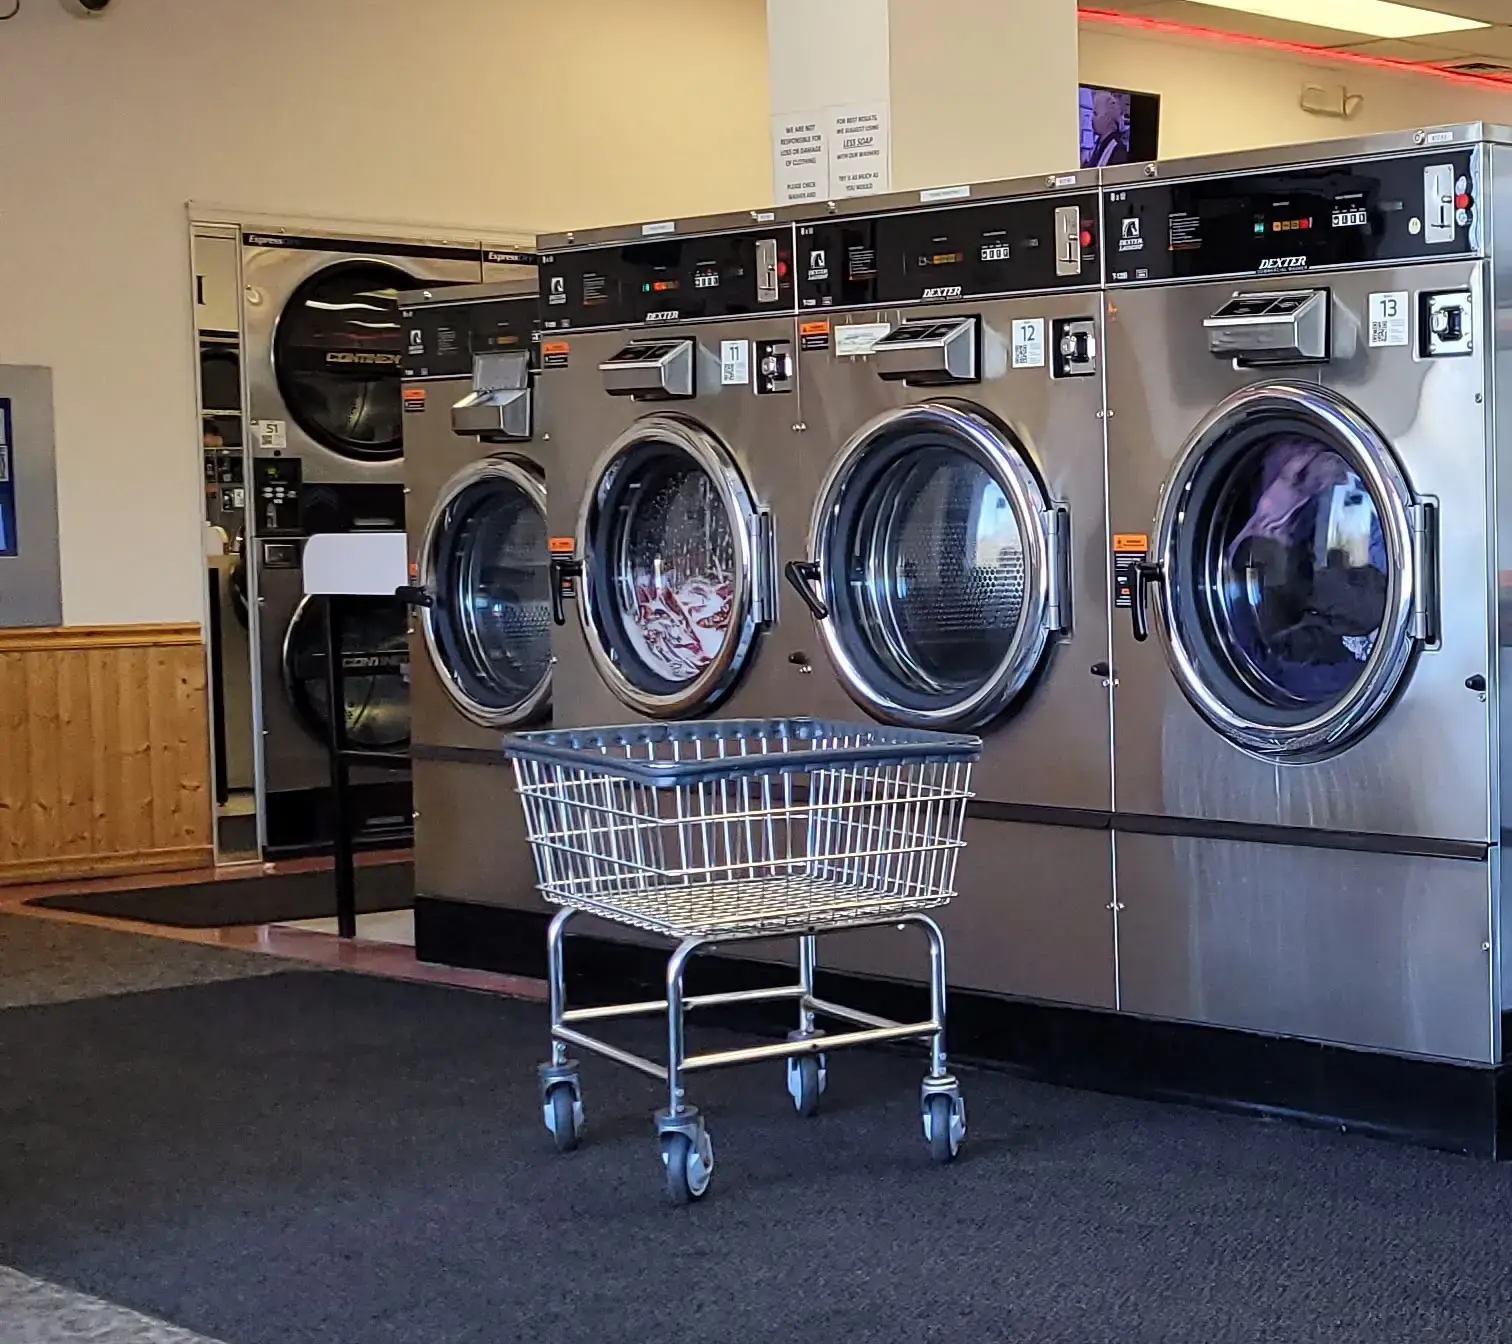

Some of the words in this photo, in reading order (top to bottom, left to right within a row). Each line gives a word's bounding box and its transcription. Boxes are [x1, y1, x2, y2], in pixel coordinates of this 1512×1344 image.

[843, 138, 856, 148] LESS
[857, 137, 874, 146] SOAP
[1259, 256, 1307, 270] DEXTER
[922, 286, 962, 299] DEXTER
[1380, 299, 1398, 318] 13
[646, 311, 680, 321] DEXTER
[1020, 325, 1036, 342] 12
[729, 346, 740, 361] 11
[265, 423, 280, 434] 51
